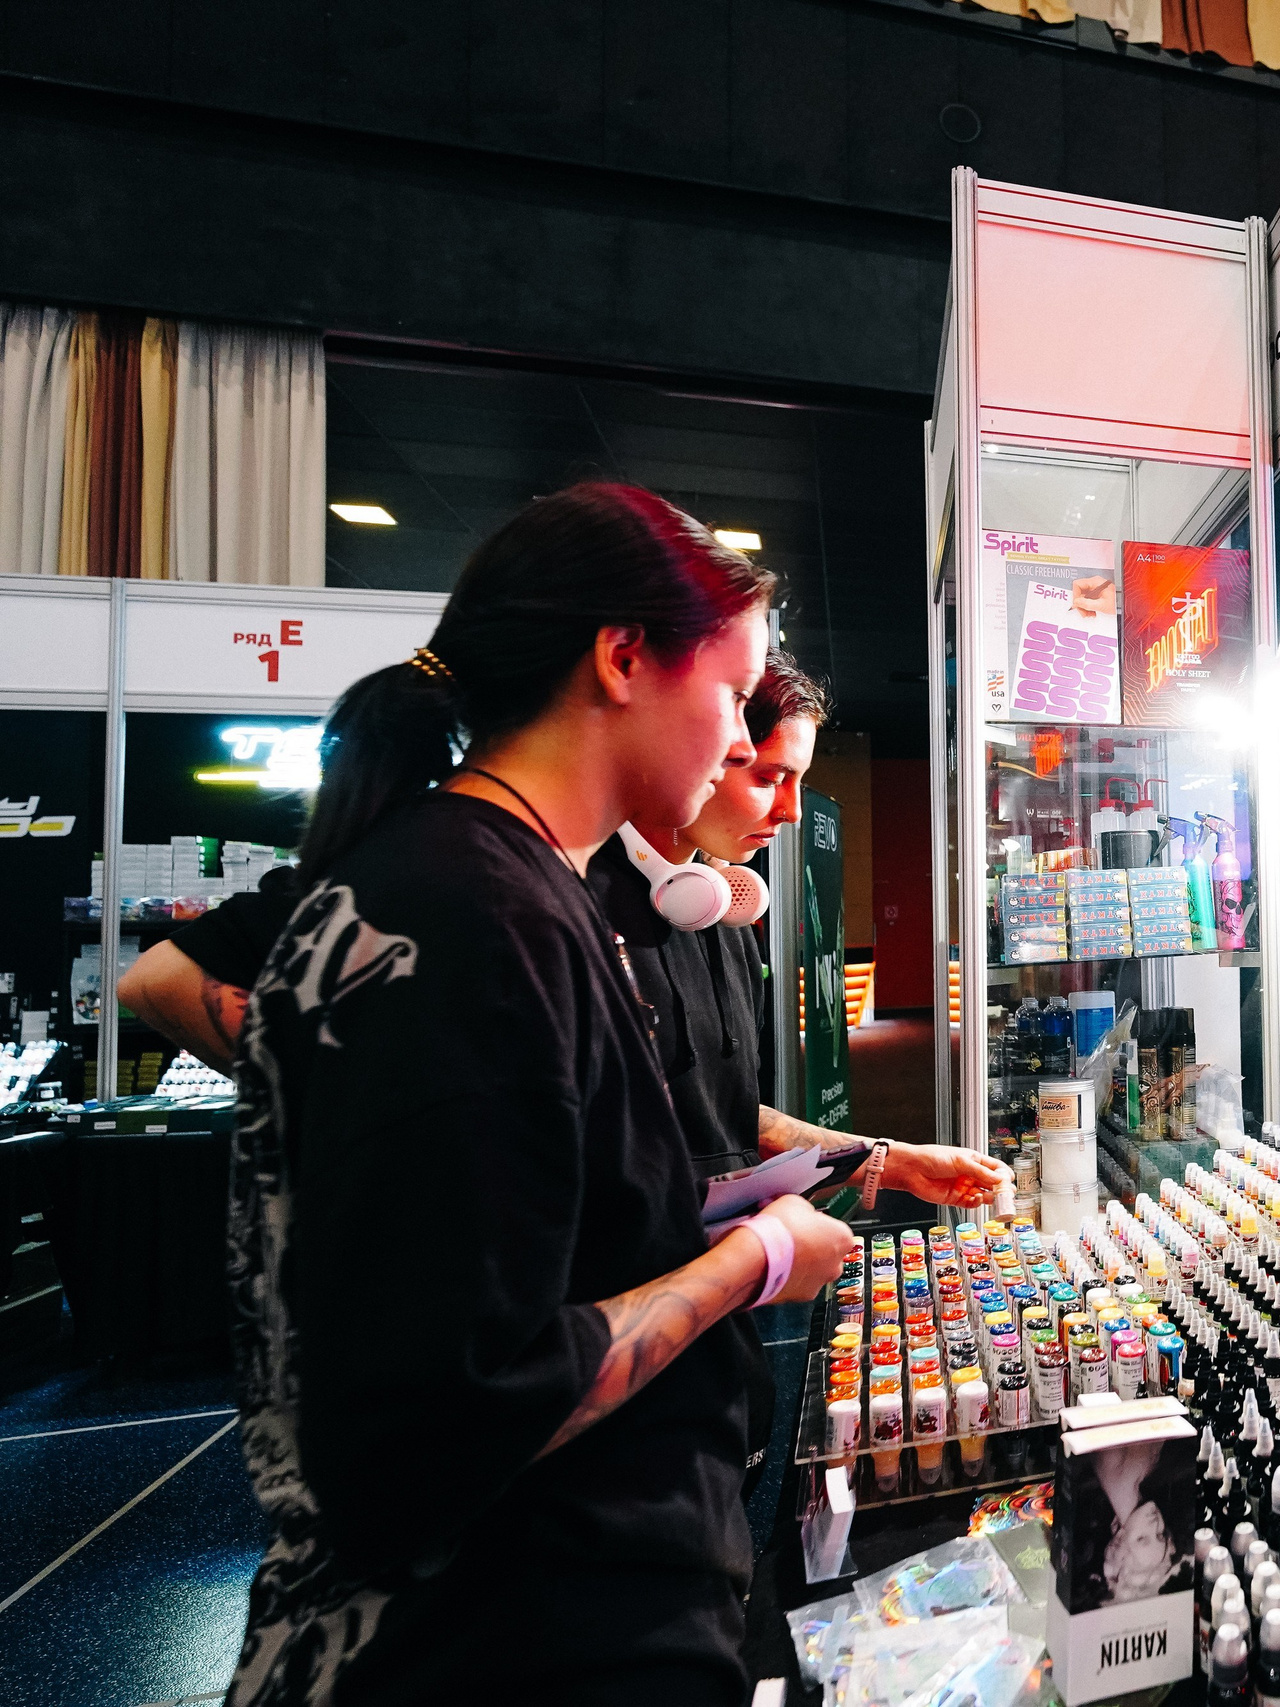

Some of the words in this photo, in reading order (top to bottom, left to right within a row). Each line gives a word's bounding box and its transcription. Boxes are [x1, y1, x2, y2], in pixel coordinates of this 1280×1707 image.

[984, 532, 1039, 556] Spirit
[1136, 553, 1152, 563] A4
[1007, 563, 1035, 576] CLASSIC
[1035, 565, 1071, 579] FREEHAND
[1034, 584, 1069, 601] Spirit
[233, 632, 273, 648] РЯД
[258, 651, 280, 683] 1
[1165, 668, 1186, 677] HOLY
[1188, 669, 1212, 678] SHEET
[1020, 878, 1055, 887] TKTX
[1020, 896, 1055, 905] TKTX
[1020, 913, 1055, 922] TKTX
[1100, 1629, 1167, 1669] KARTIN
